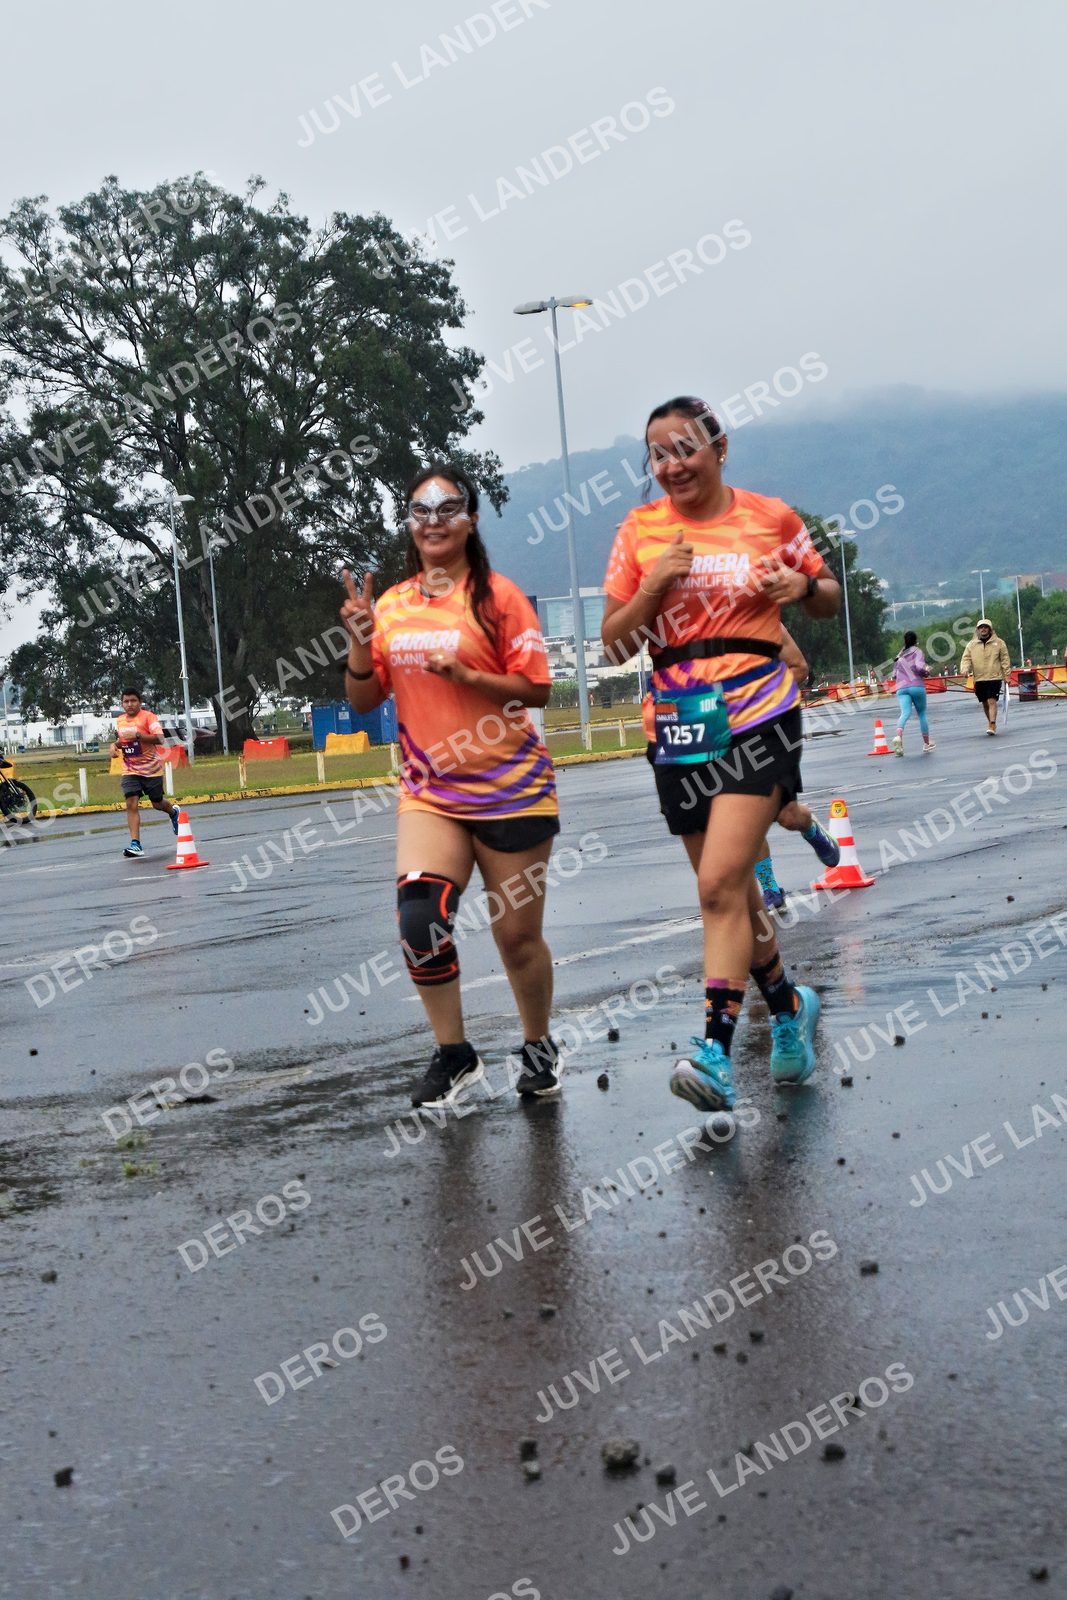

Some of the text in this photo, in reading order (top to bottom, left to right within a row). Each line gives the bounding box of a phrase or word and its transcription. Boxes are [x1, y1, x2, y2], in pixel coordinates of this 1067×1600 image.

[690, 553, 750, 574] RRERA
[391, 652, 428, 667] OMNIL
[700, 697, 718, 712] 10K
[663, 723, 705, 746] 1257
